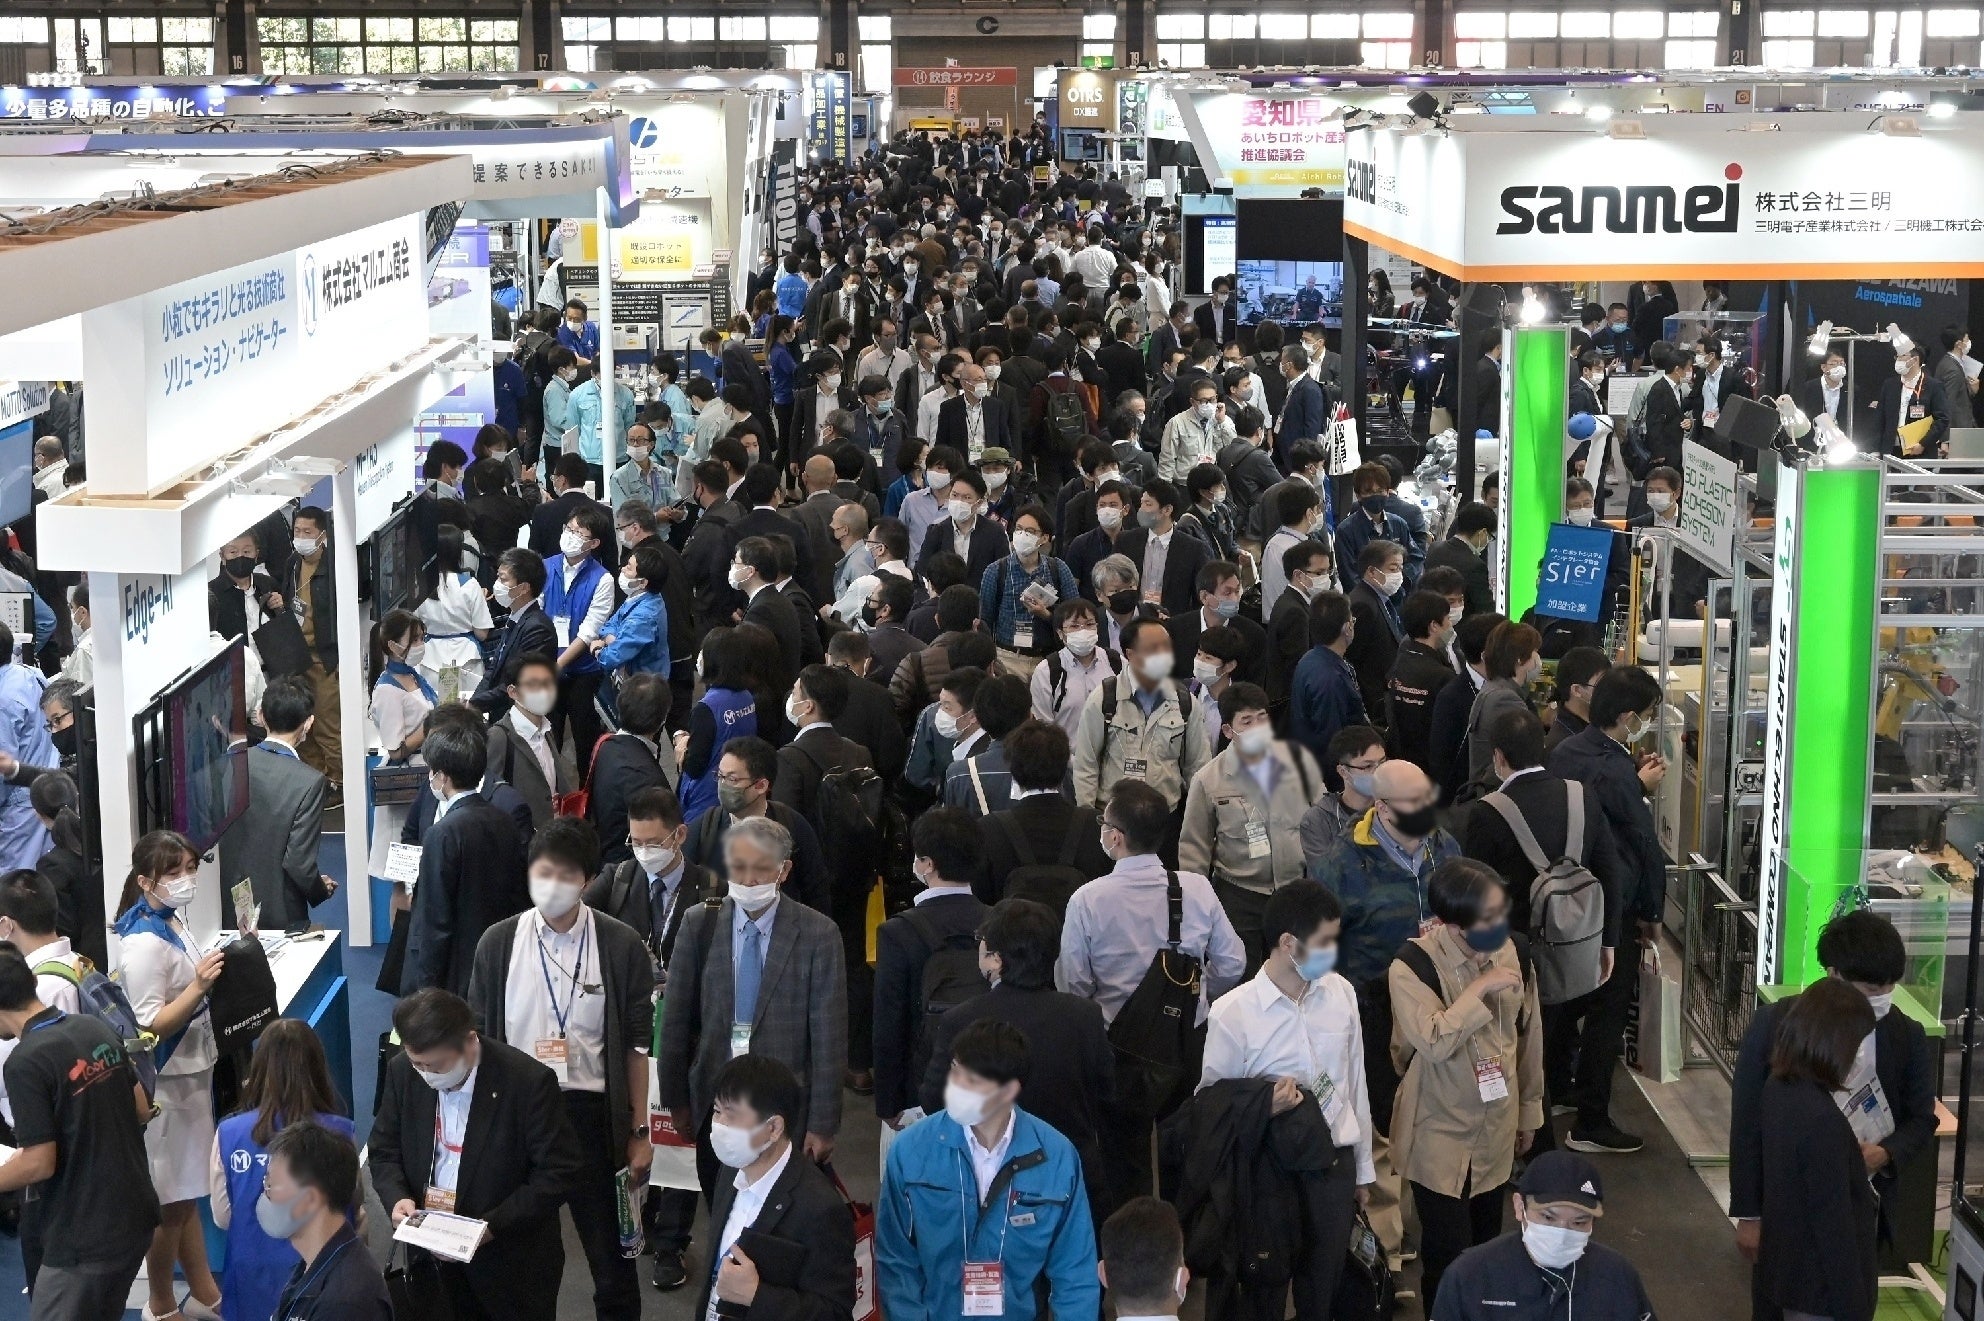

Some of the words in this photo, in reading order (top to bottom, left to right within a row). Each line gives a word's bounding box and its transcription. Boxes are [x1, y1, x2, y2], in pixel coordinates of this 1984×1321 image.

[976, 16, 999, 34] C
[232, 55, 243, 69] 16
[538, 53, 549, 67] 17
[835, 52, 845, 66] 18
[1130, 51, 1140, 65] 19
[1426, 55, 1439, 69] 20
[1733, 49, 1744, 64] 21
[1242, 99, 1321, 126] 愛知県
[1241, 148, 1306, 162] 推進協議会
[1495, 162, 1743, 235] sanmei
[1755, 191, 1891, 212] 株式会社三明
[775, 157, 797, 268] THOUZ
[1894, 218, 1984, 232] 三明機工株式会
[322, 236, 410, 314] 株式会社マルエム商会
[1855, 286, 1922, 308] Aerospatiale
[1683, 490, 1726, 529] ADHESION
[1681, 512, 1715, 547] SYSTEM
[124, 574, 173, 645] Edge-AI
[1771, 617, 1787, 844] STARTECHNO
[1764, 849, 1777, 986] COMPAN
